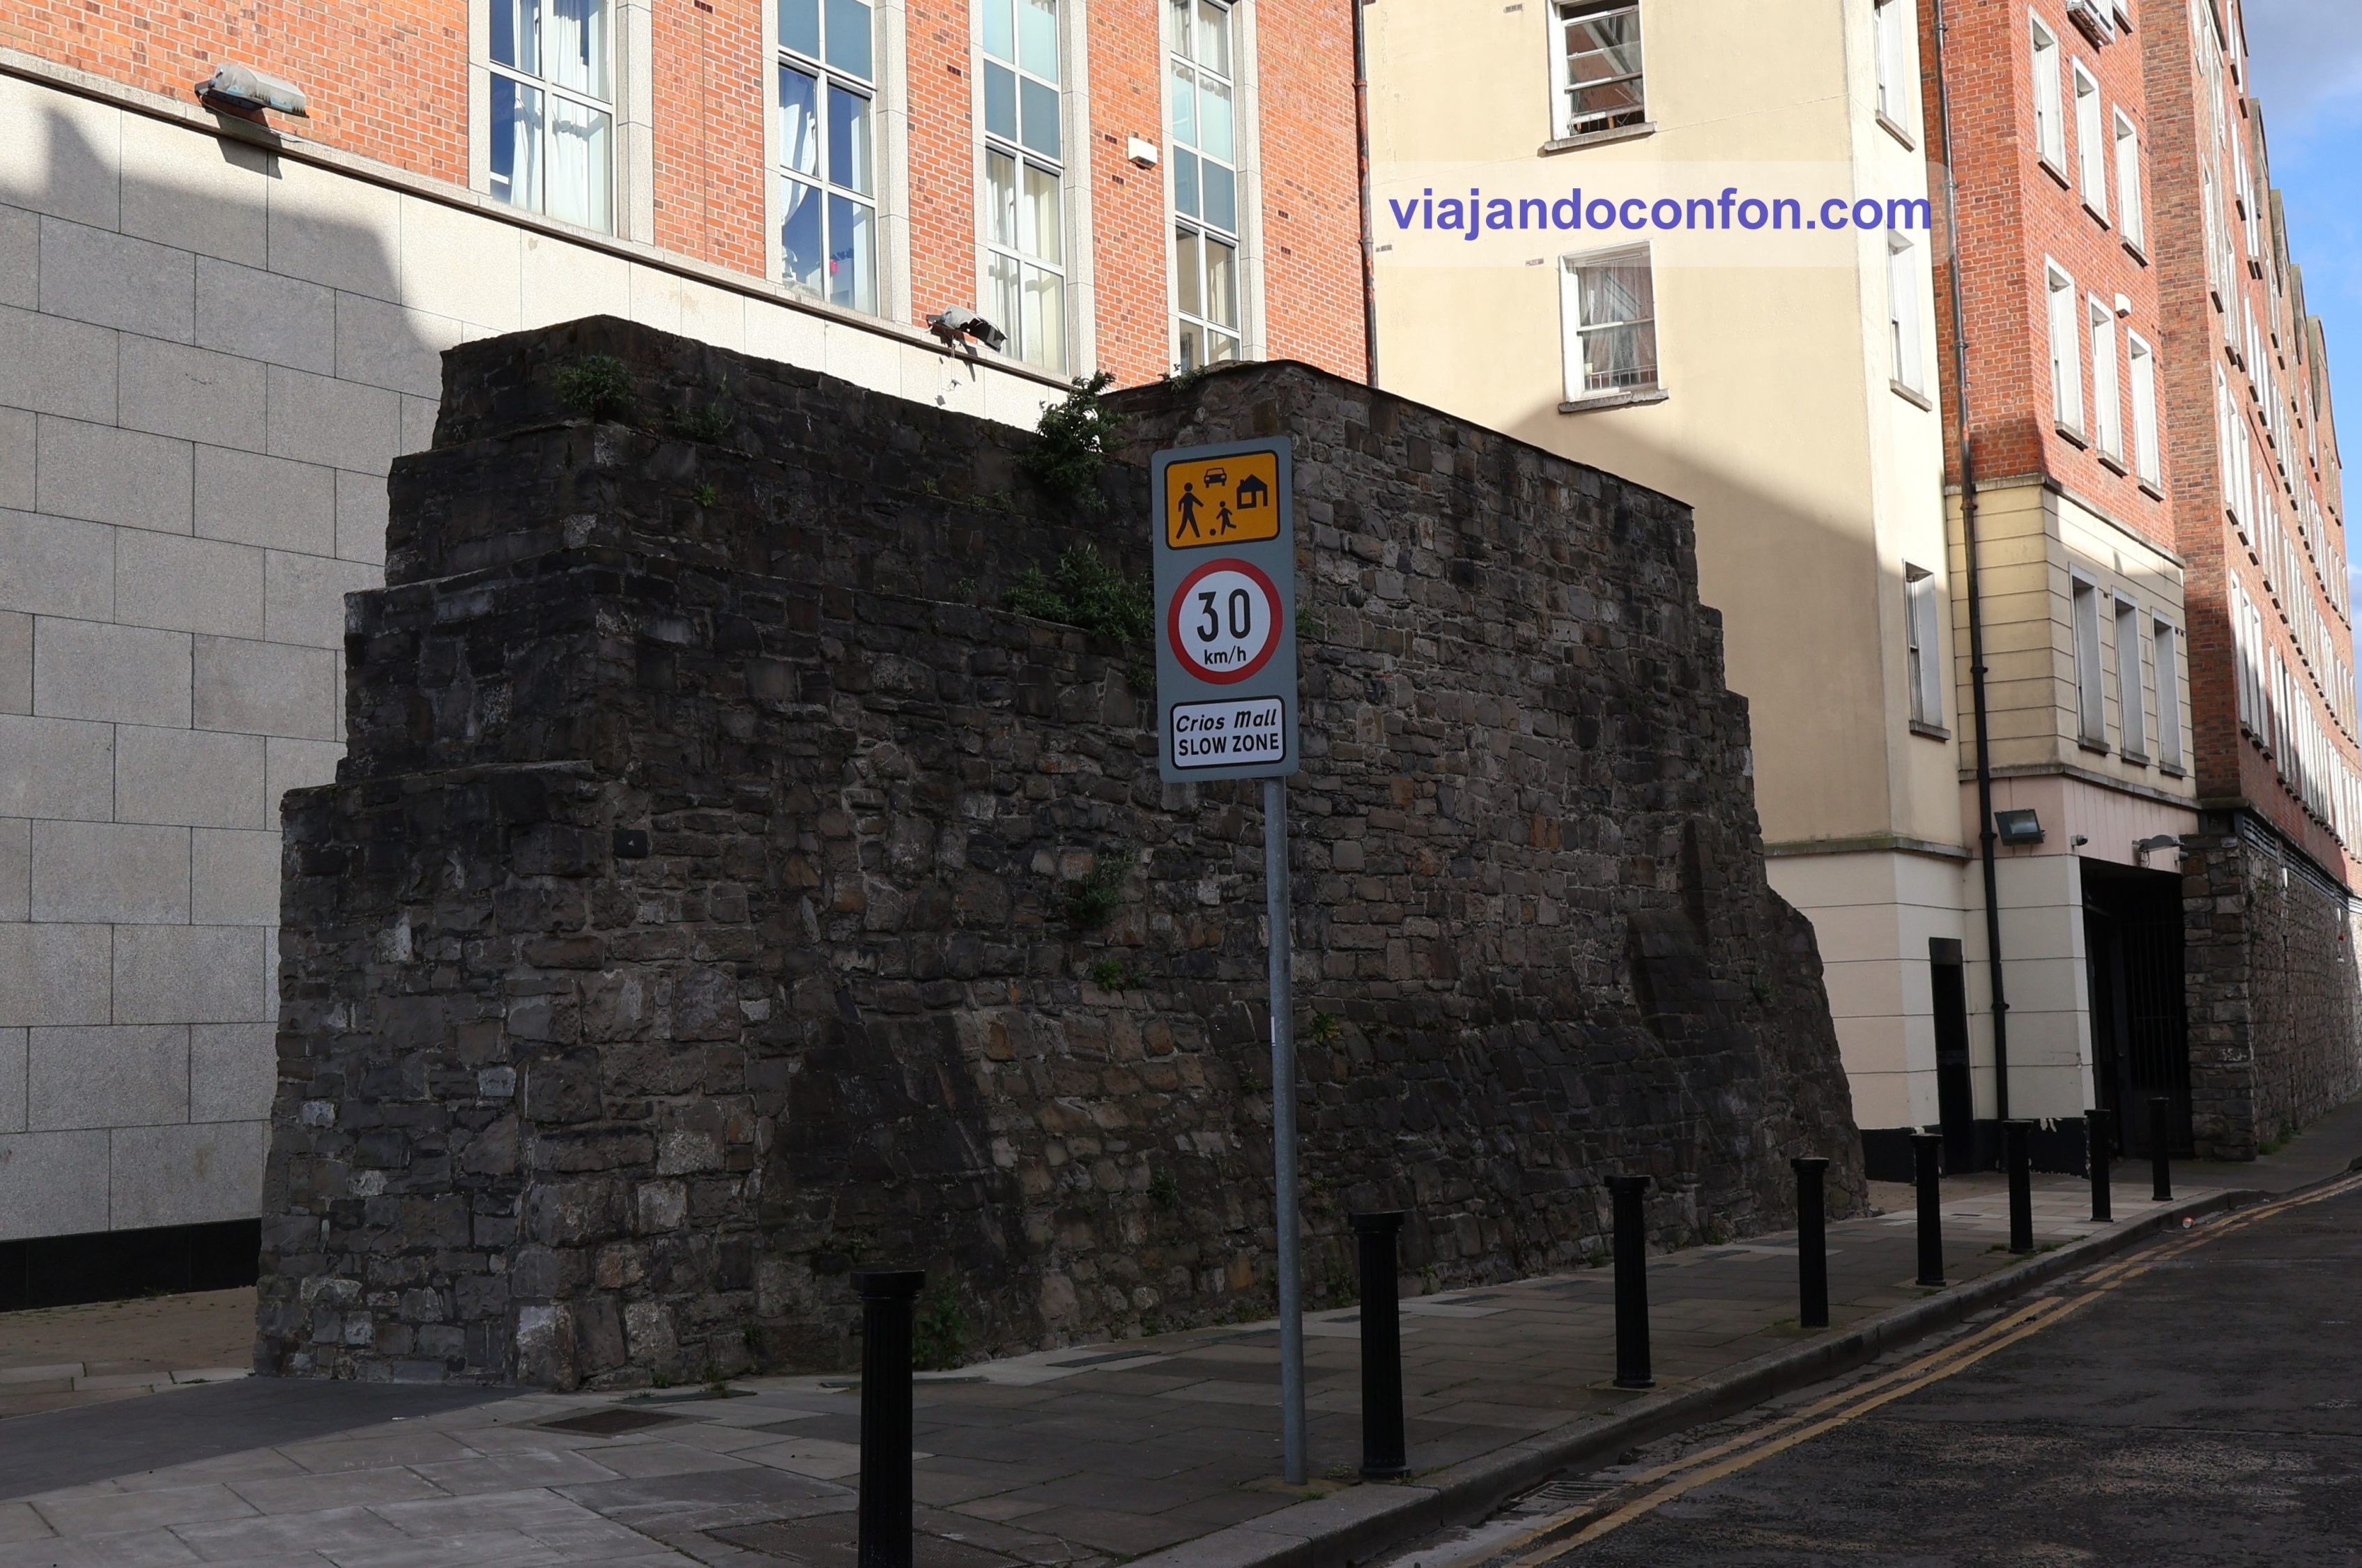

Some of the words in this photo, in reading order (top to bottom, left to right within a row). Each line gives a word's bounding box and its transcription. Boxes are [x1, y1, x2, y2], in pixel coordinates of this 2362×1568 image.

[1197, 589, 1250, 642] 30
[1204, 645, 1247, 665] km/h
[1176, 715, 1225, 732] Crios
[1234, 709, 1277, 728] Mall
[1179, 736, 1227, 756] SLOW
[1232, 733, 1279, 752] ZONE
